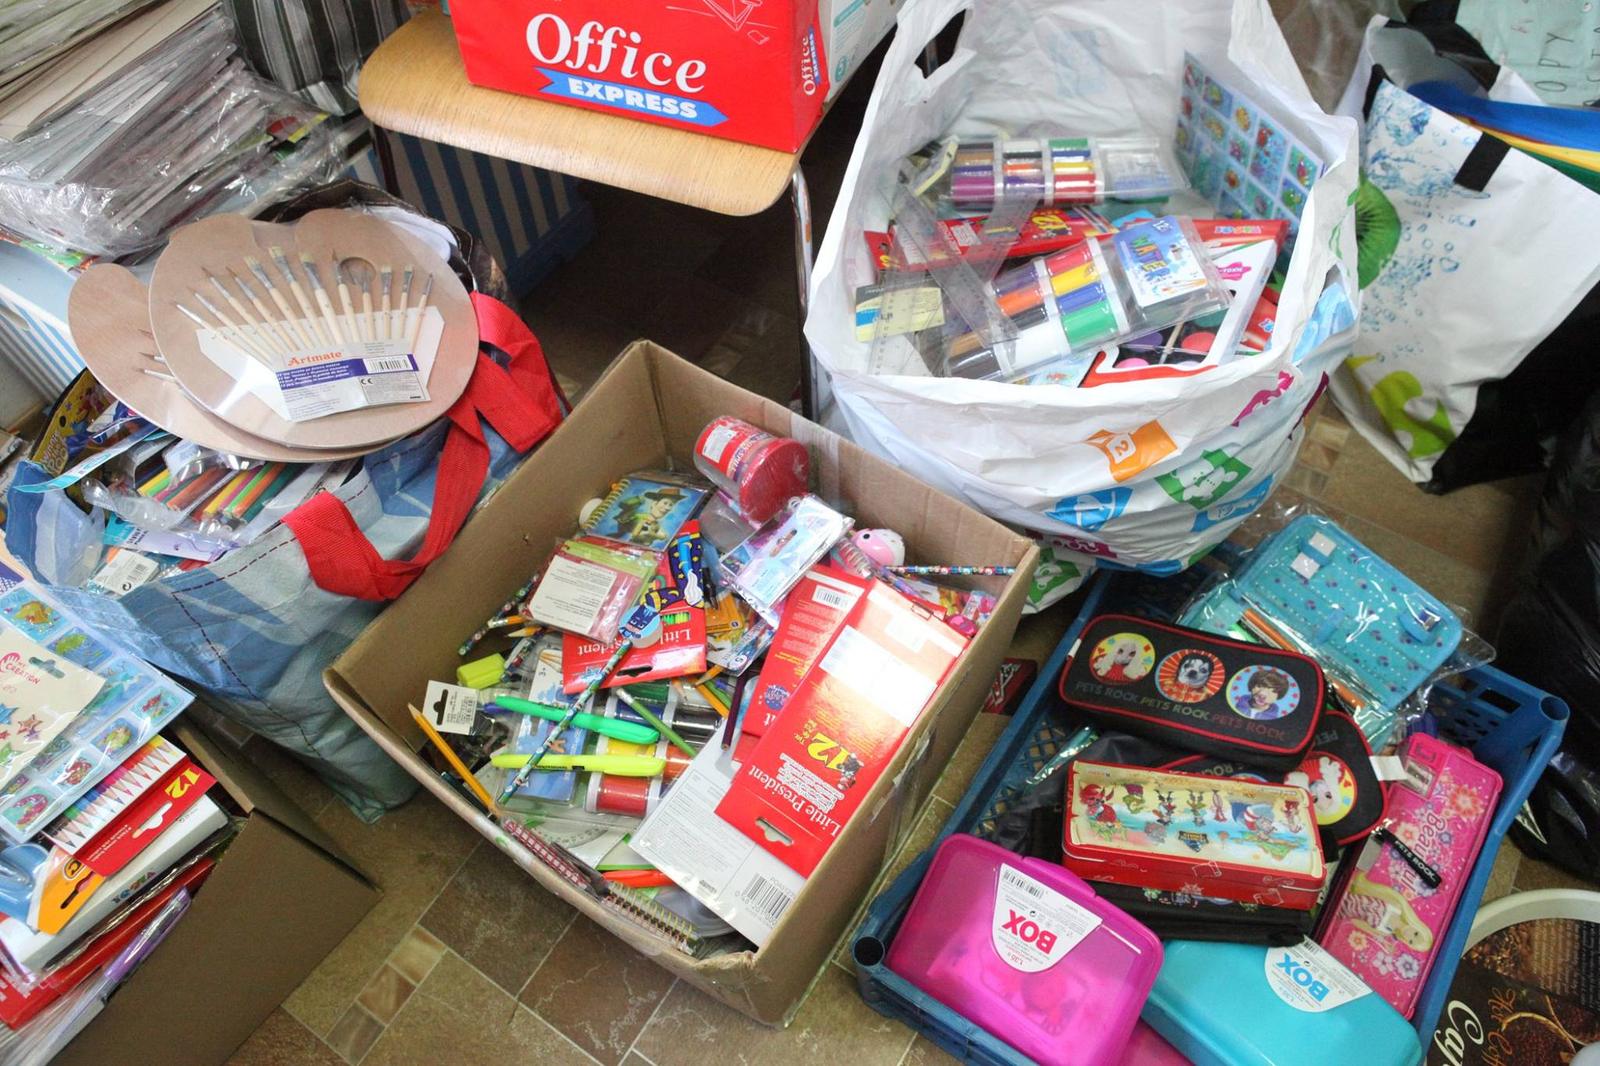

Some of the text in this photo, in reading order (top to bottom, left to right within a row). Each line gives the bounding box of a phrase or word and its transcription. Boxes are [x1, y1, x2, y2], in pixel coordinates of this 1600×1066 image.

[525, 12, 707, 94] Office
[801, 35, 817, 96] Office
[567, 77, 699, 119] EXPRESS
[1130, 234, 1172, 282] WATER
[287, 350, 343, 367] Artmate
[659, 628, 692, 645] Littl
[1075, 681, 1139, 701] PETS ROCK
[1140, 696, 1211, 721] PETS ROCK
[1212, 713, 1286, 741] PETS ROCK
[807, 732, 850, 773] 12
[164, 767, 201, 799] 12
[748, 764, 807, 813] President
[805, 804, 841, 837] Little
[1401, 812, 1446, 893] Beauul
[1412, 857, 1436, 883] ROCK
[1001, 908, 1058, 955] BOX
[1276, 952, 1330, 1002] BOX
